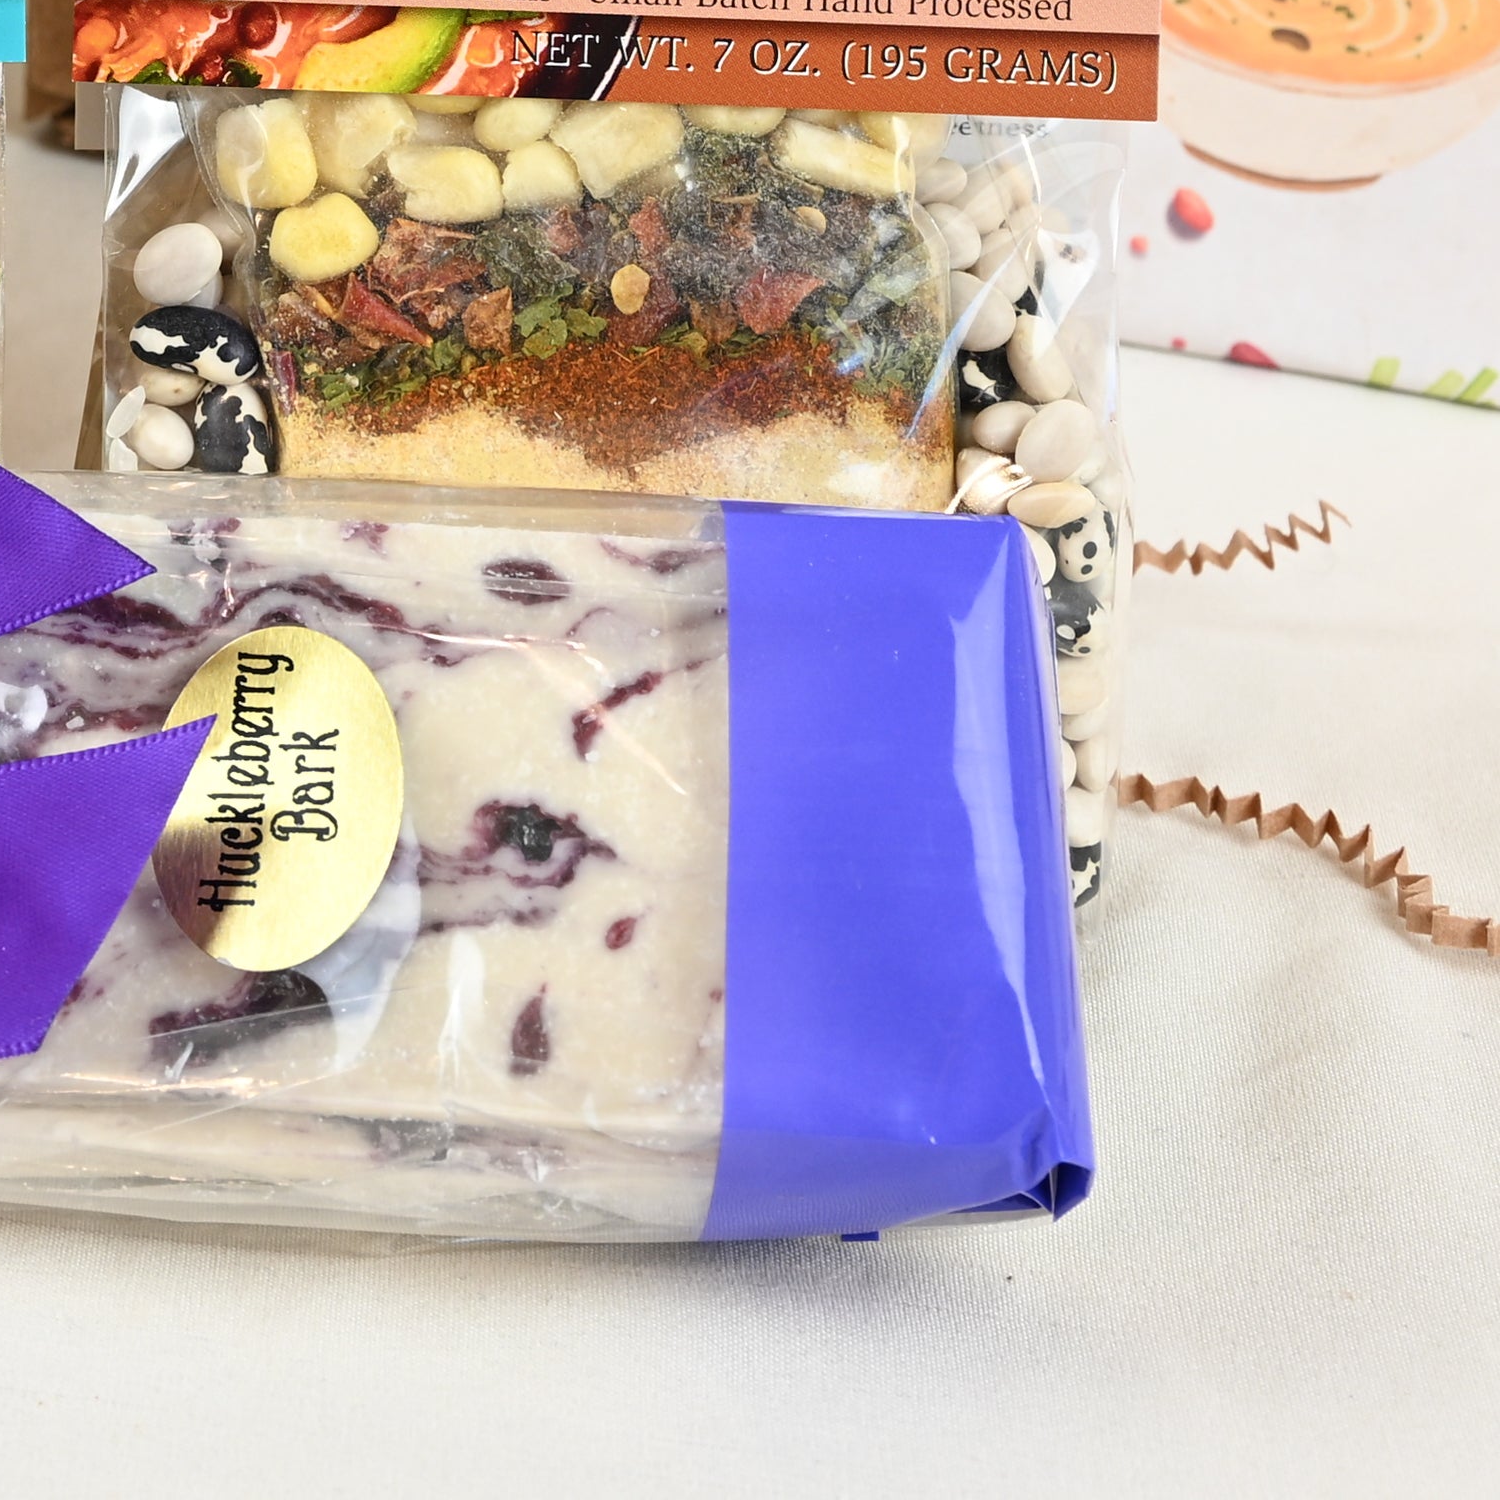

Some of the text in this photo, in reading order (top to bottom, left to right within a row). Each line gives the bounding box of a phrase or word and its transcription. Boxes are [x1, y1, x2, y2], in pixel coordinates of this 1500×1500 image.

[511, 29, 1119, 95] NET WT. 7 OZ. (195 GRAMS)
[197, 651, 295, 913] Huckleberry
[269, 727, 340, 843] Bark
